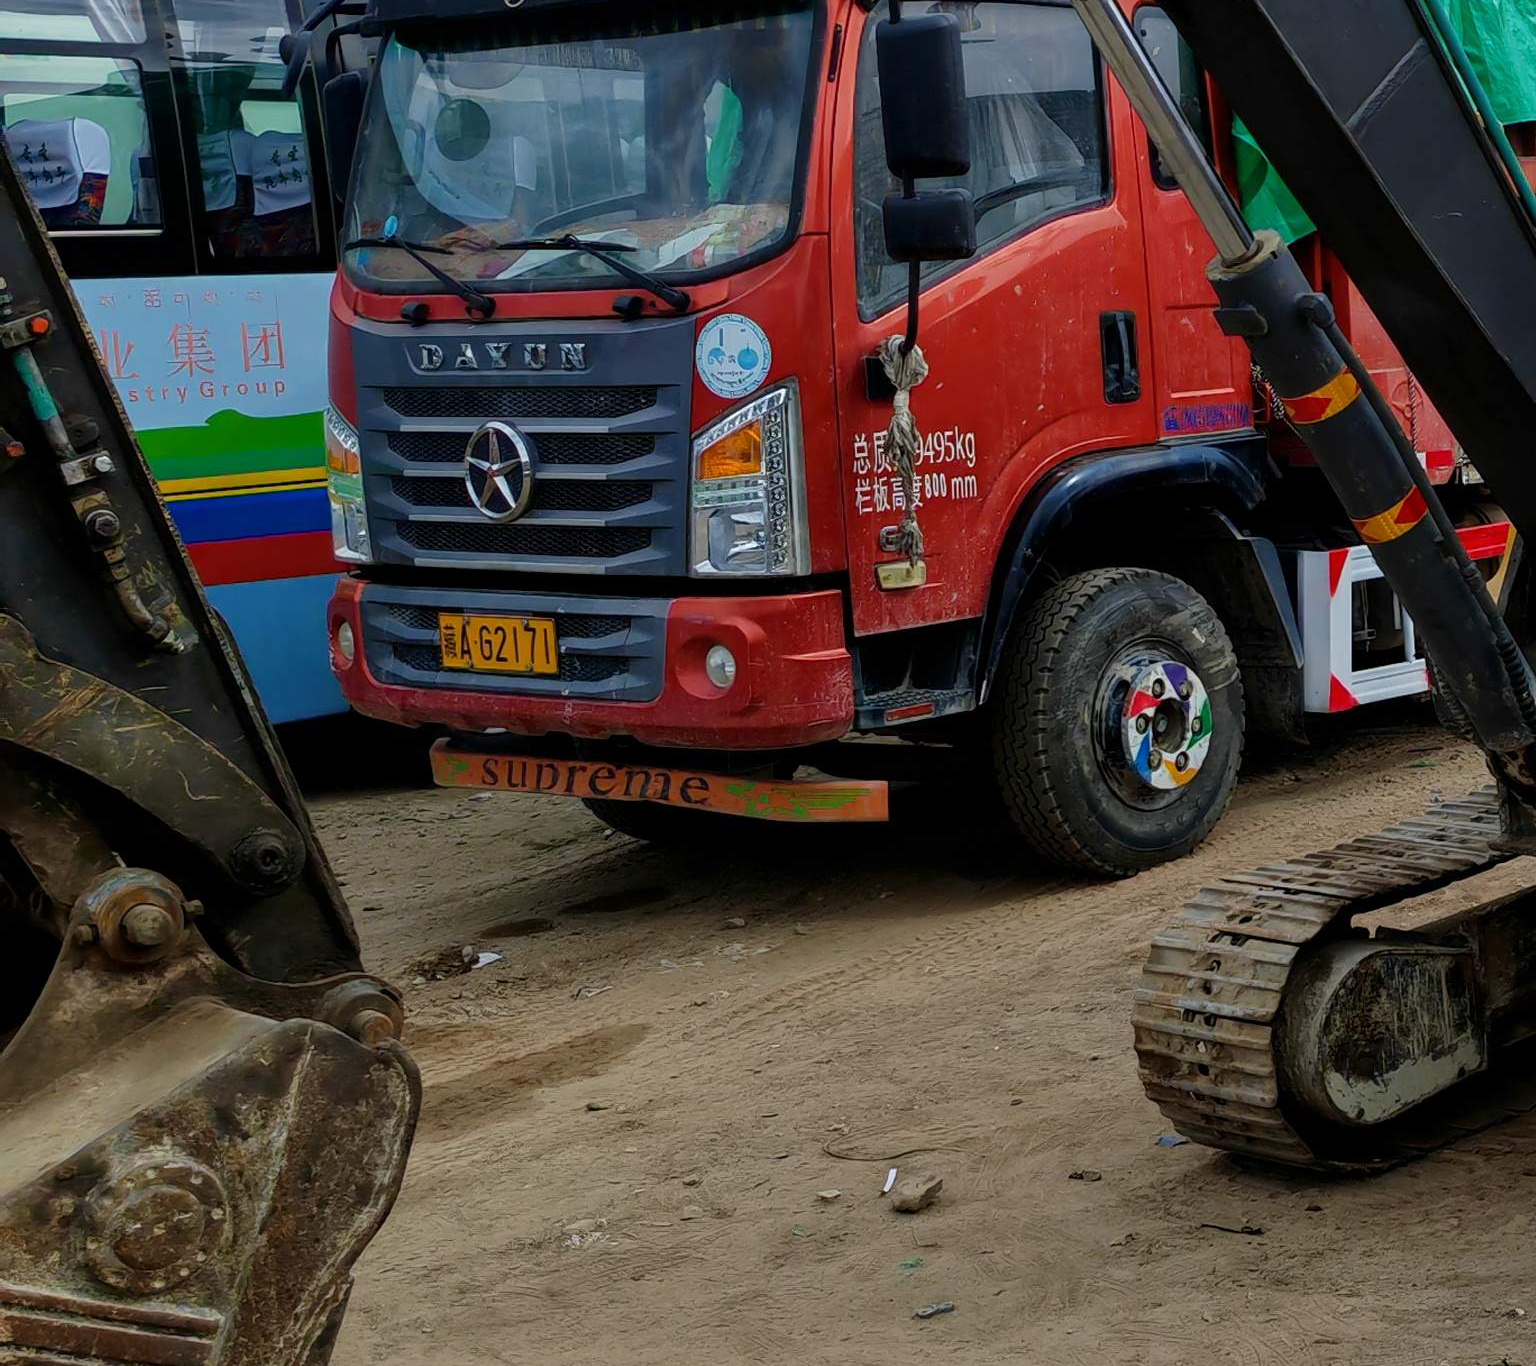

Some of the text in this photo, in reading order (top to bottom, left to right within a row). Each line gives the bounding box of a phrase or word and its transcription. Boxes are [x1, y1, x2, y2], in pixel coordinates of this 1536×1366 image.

[418, 342, 587, 371] DAYUN
[200, 380, 286, 399] Group
[481, 755, 711, 804] supreme
